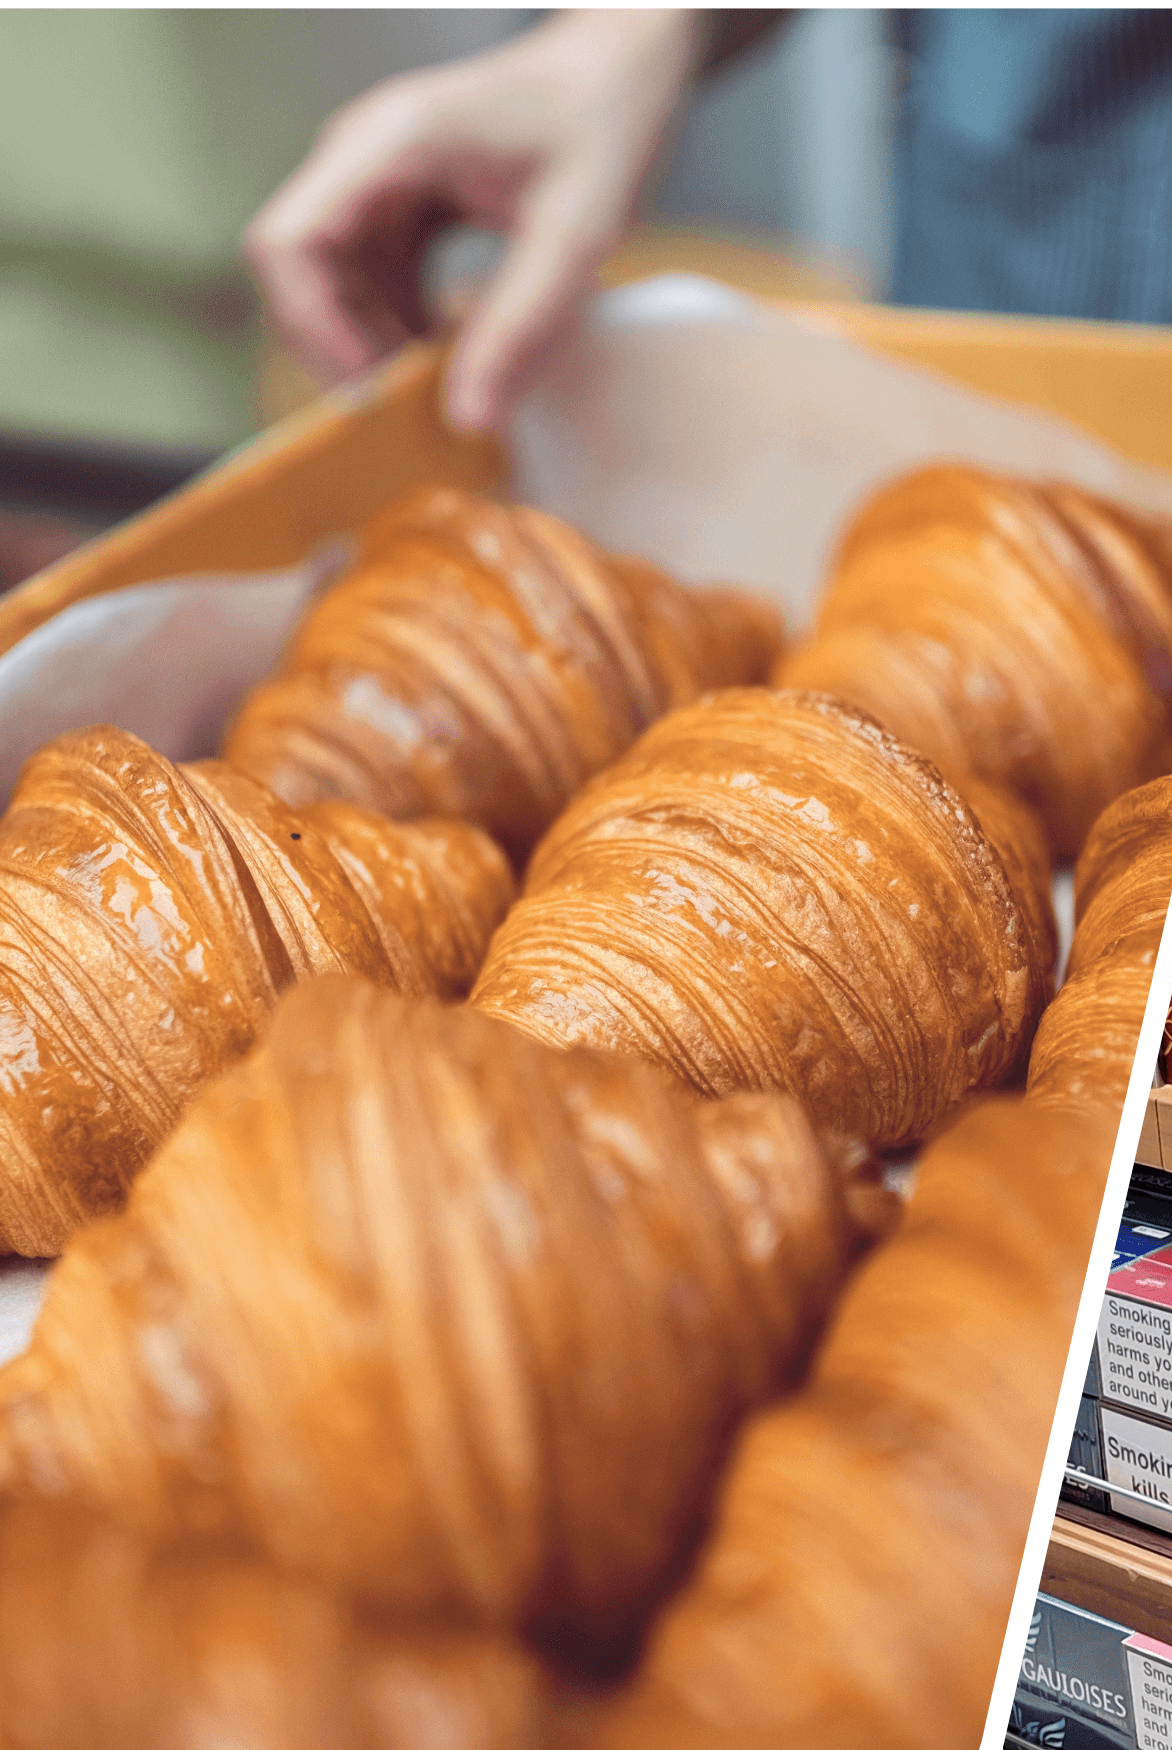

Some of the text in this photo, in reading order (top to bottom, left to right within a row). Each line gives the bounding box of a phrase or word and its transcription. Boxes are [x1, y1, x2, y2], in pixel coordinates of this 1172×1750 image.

[1109, 1299, 1172, 1335] Smoking
[1107, 1338, 1150, 1365] harms
[1109, 1361, 1134, 1379] and
[1109, 1380, 1158, 1406] around
[1022, 1657, 1127, 1718] GAULOISES
[1143, 1717, 1168, 1737] and
